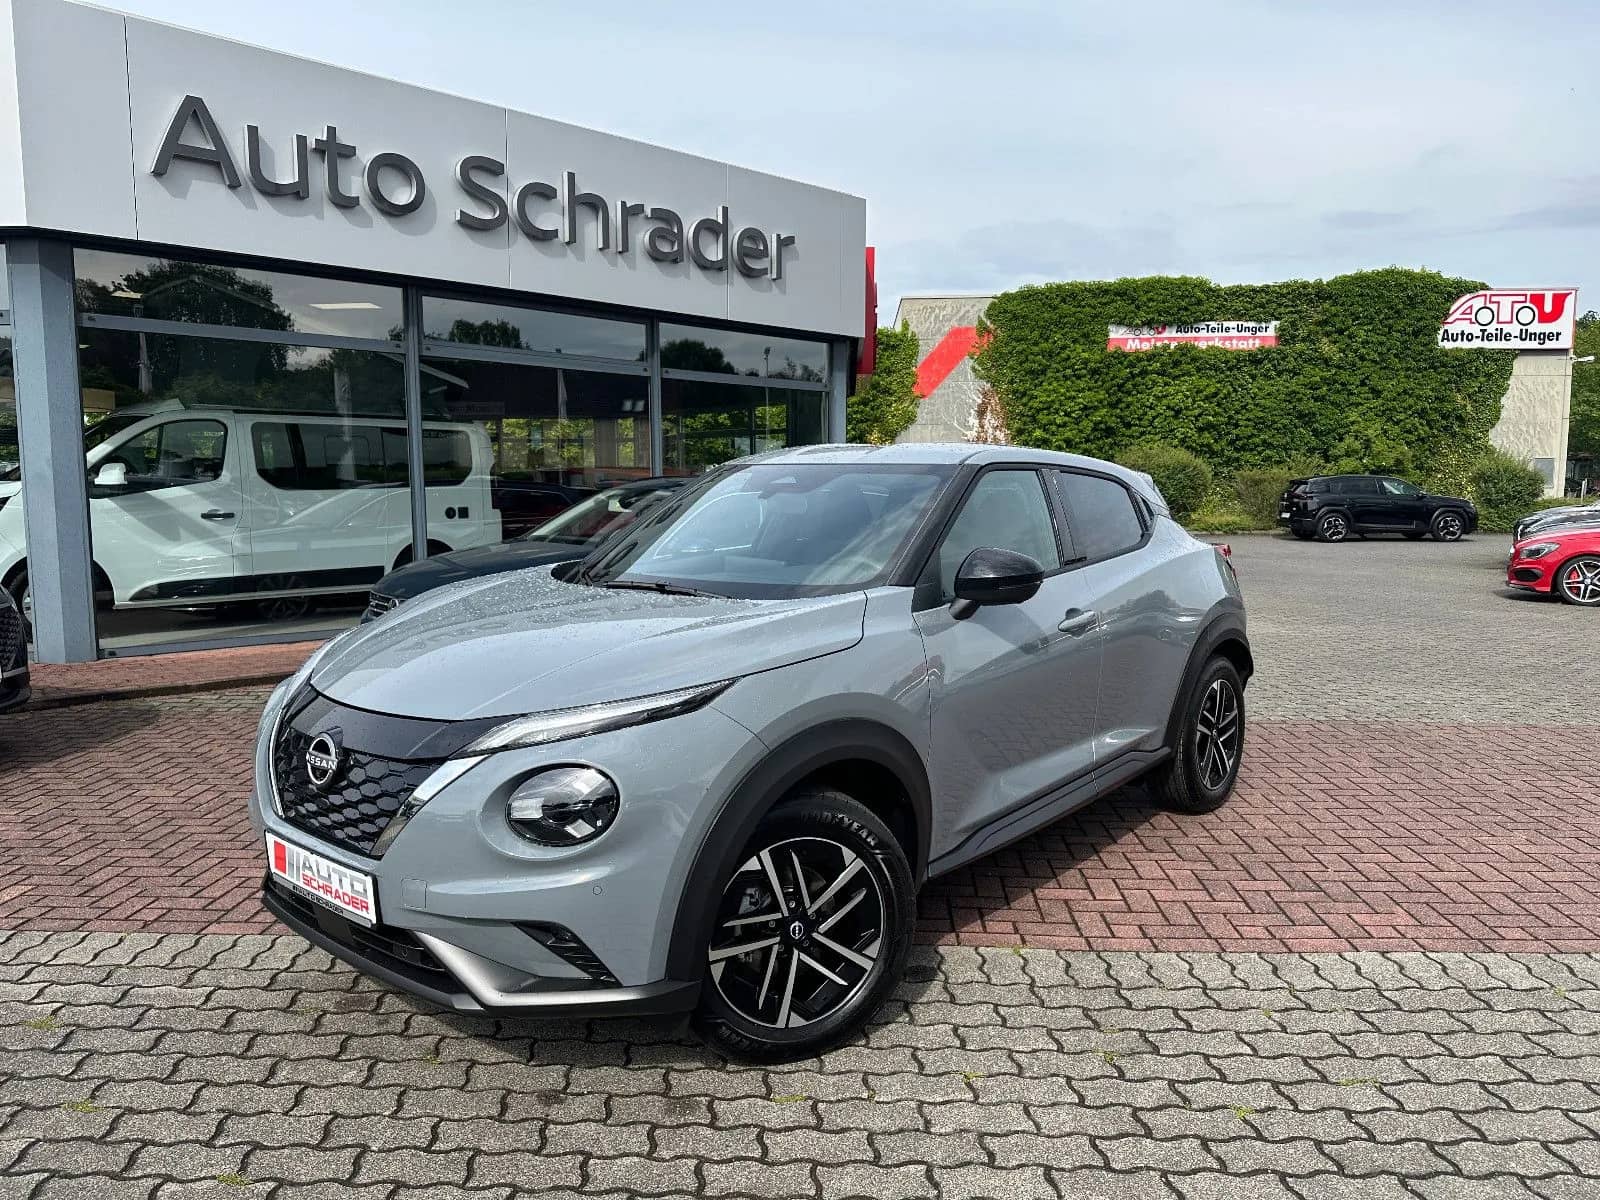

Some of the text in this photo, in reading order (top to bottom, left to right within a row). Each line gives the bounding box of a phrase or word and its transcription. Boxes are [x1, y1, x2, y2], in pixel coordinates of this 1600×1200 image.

[150, 94, 795, 281] Auto Schrader
[1175, 323, 1270, 336] Auto-Teile-Unger
[1440, 328, 1562, 346] Auto-Teile-Unger
[1126, 336, 1261, 350] Meieerkstatt
[306, 751, 339, 770] NISSAN
[301, 854, 369, 900] AUTO
[302, 873, 370, 914] SCHRADER
